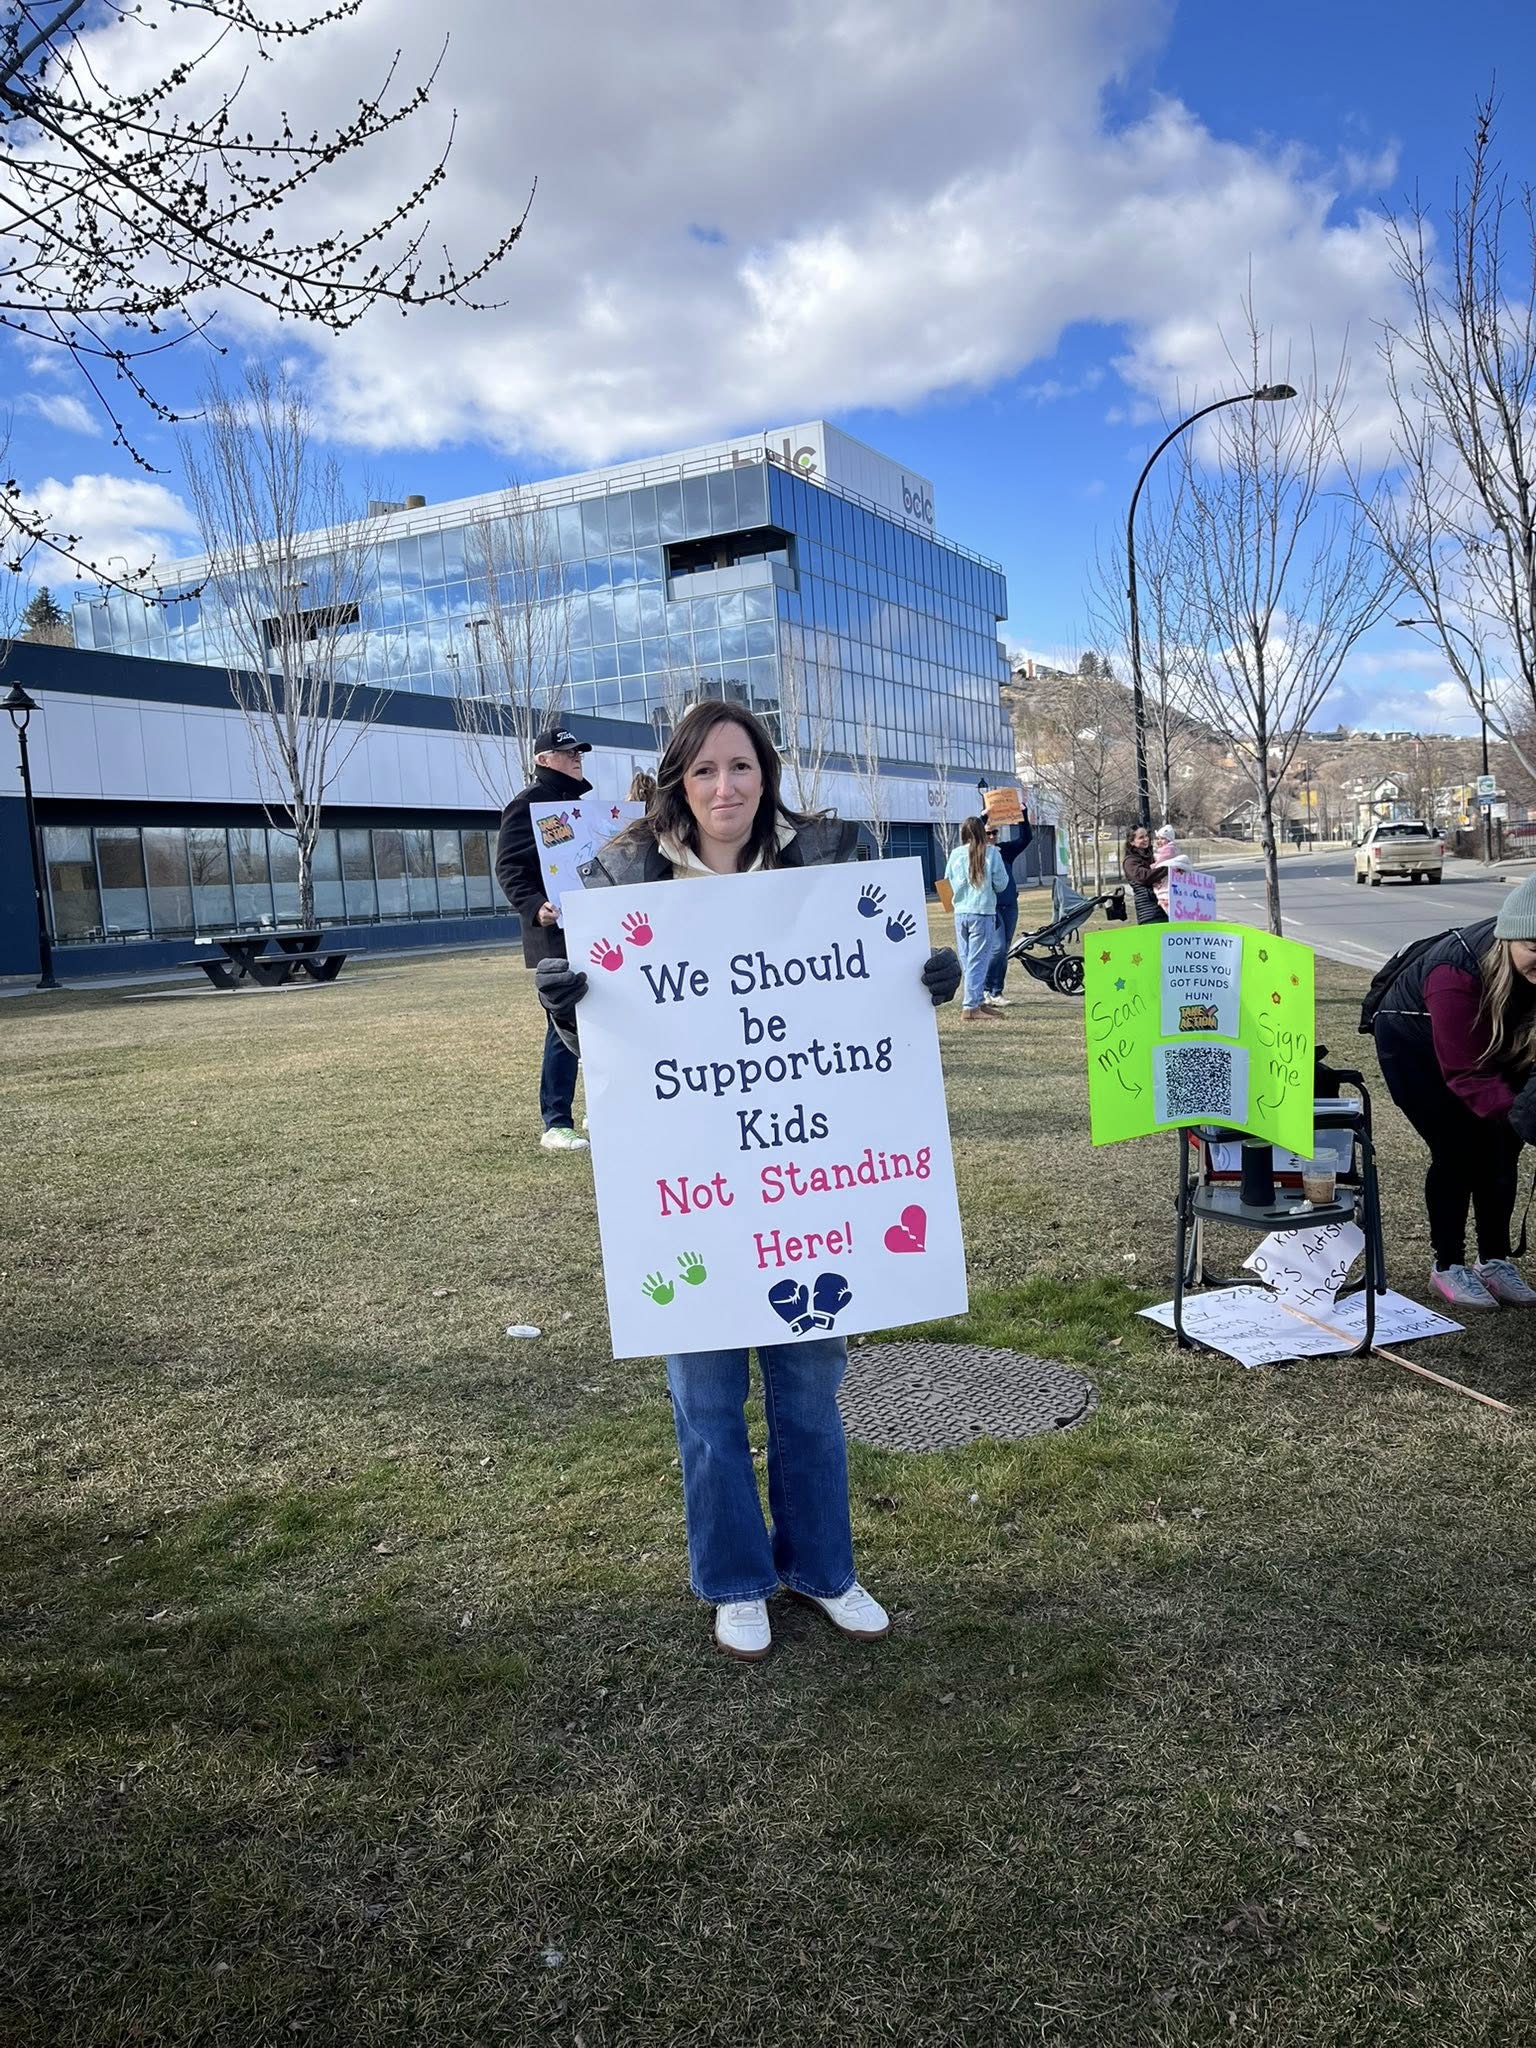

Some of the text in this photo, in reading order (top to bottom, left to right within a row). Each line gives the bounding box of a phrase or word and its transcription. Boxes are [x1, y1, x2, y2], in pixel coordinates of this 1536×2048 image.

[901, 475, 934, 524] bclc
[1168, 937, 1234, 948] DON'T WANT
[1185, 951, 1216, 960] NONE
[640, 939, 870, 1004] We Should
[1168, 965, 1231, 976] UNLESS YOU
[1170, 978, 1229, 989] GOT FUNDS
[1185, 992, 1213, 1001] HUN!
[740, 1007, 787, 1045] be
[1091, 994, 1147, 1042] Scan
[1257, 1012, 1307, 1064] Sign
[654, 1037, 893, 1100] Supporting
[1098, 1039, 1135, 1072] me
[1269, 1059, 1301, 1087] me
[736, 1104, 829, 1151] Kids
[656, 1146, 932, 1217] Not Standing
[752, 1221, 853, 1269] Here!
[1295, 1260, 1349, 1306] these
[1393, 1307, 1417, 1316] to
